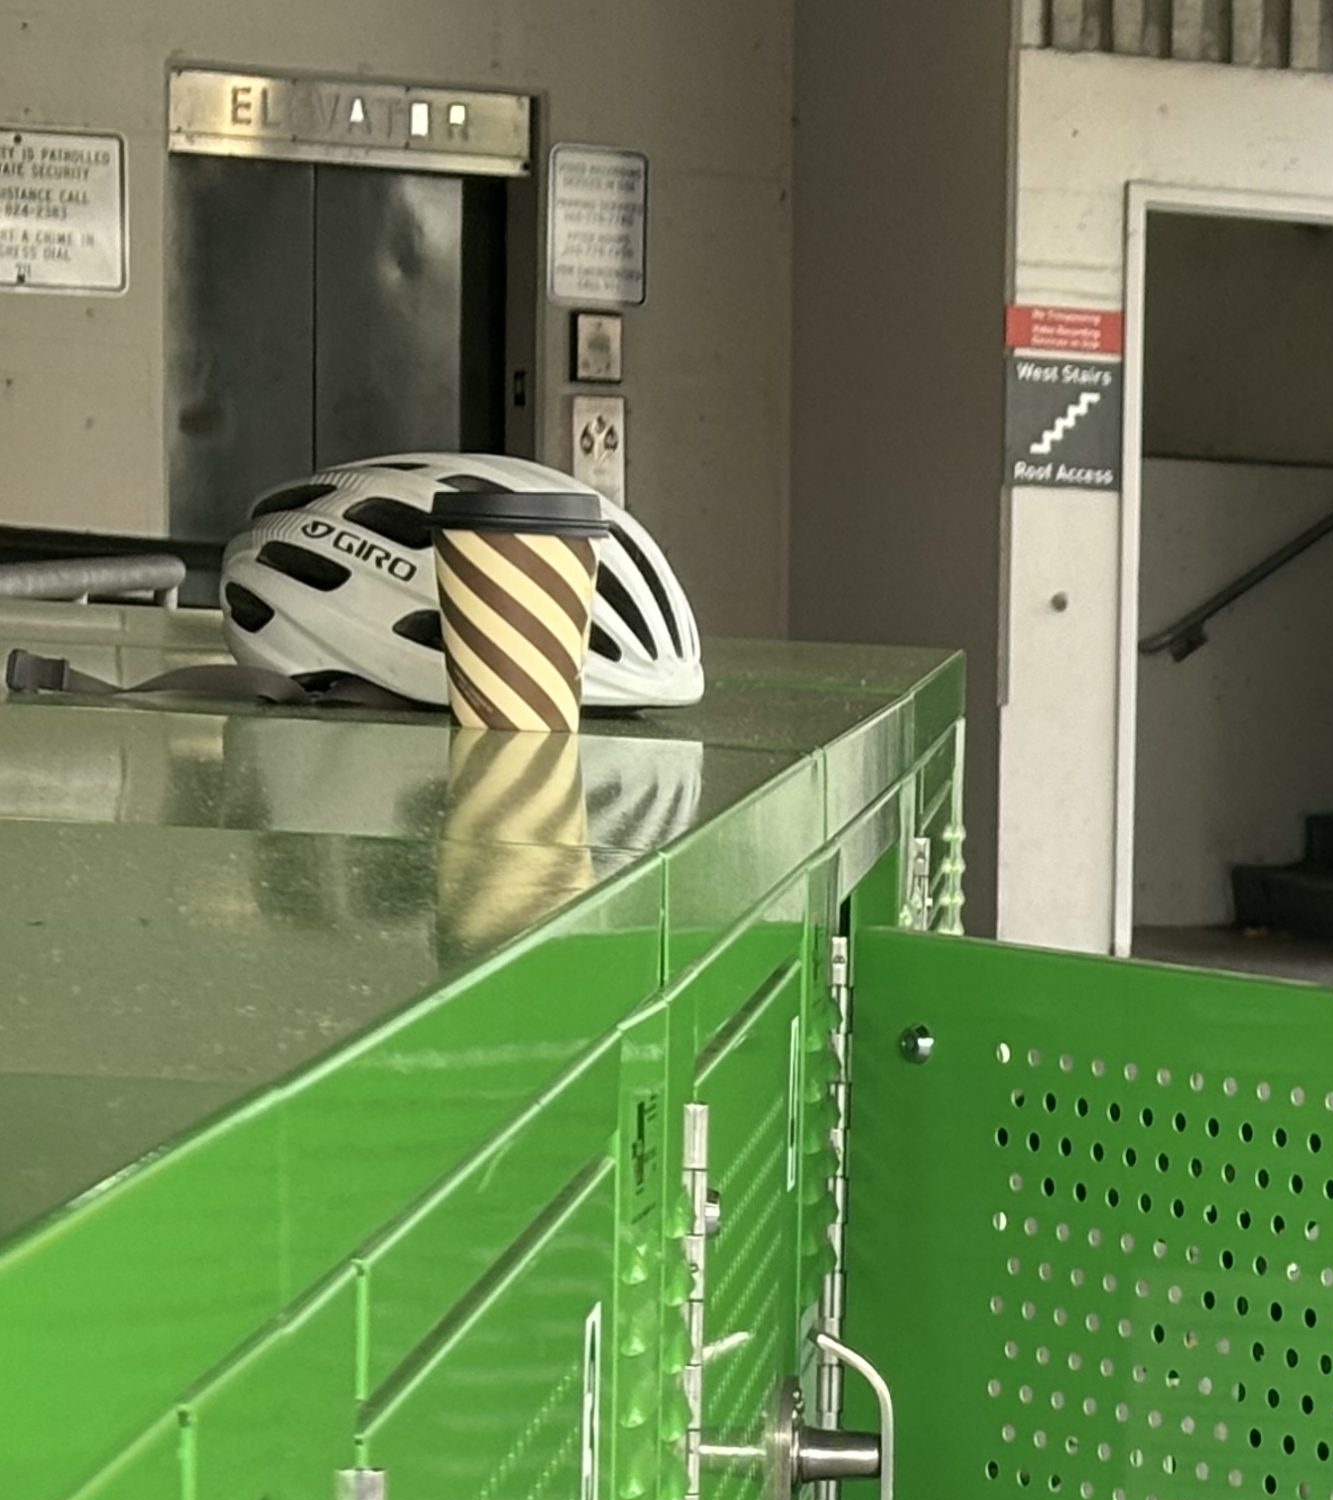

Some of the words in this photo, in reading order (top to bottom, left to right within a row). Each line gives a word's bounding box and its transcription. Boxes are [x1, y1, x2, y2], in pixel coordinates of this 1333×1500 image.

[230, 85, 470, 141] ELVATOR
[41, 148, 110, 167] PATROLLED
[32, 163, 89, 181] SECURITY
[59, 189, 90, 206] CALL
[21, 230, 28, 243] A
[35, 230, 72, 247] CRIME
[43, 246, 70, 262] DIAL
[1016, 362, 1058, 383] West
[1062, 364, 1112, 387] Stairs
[1014, 460, 1053, 481] Roof
[1056, 463, 1114, 486] Access
[333, 530, 417, 582] GIRO
